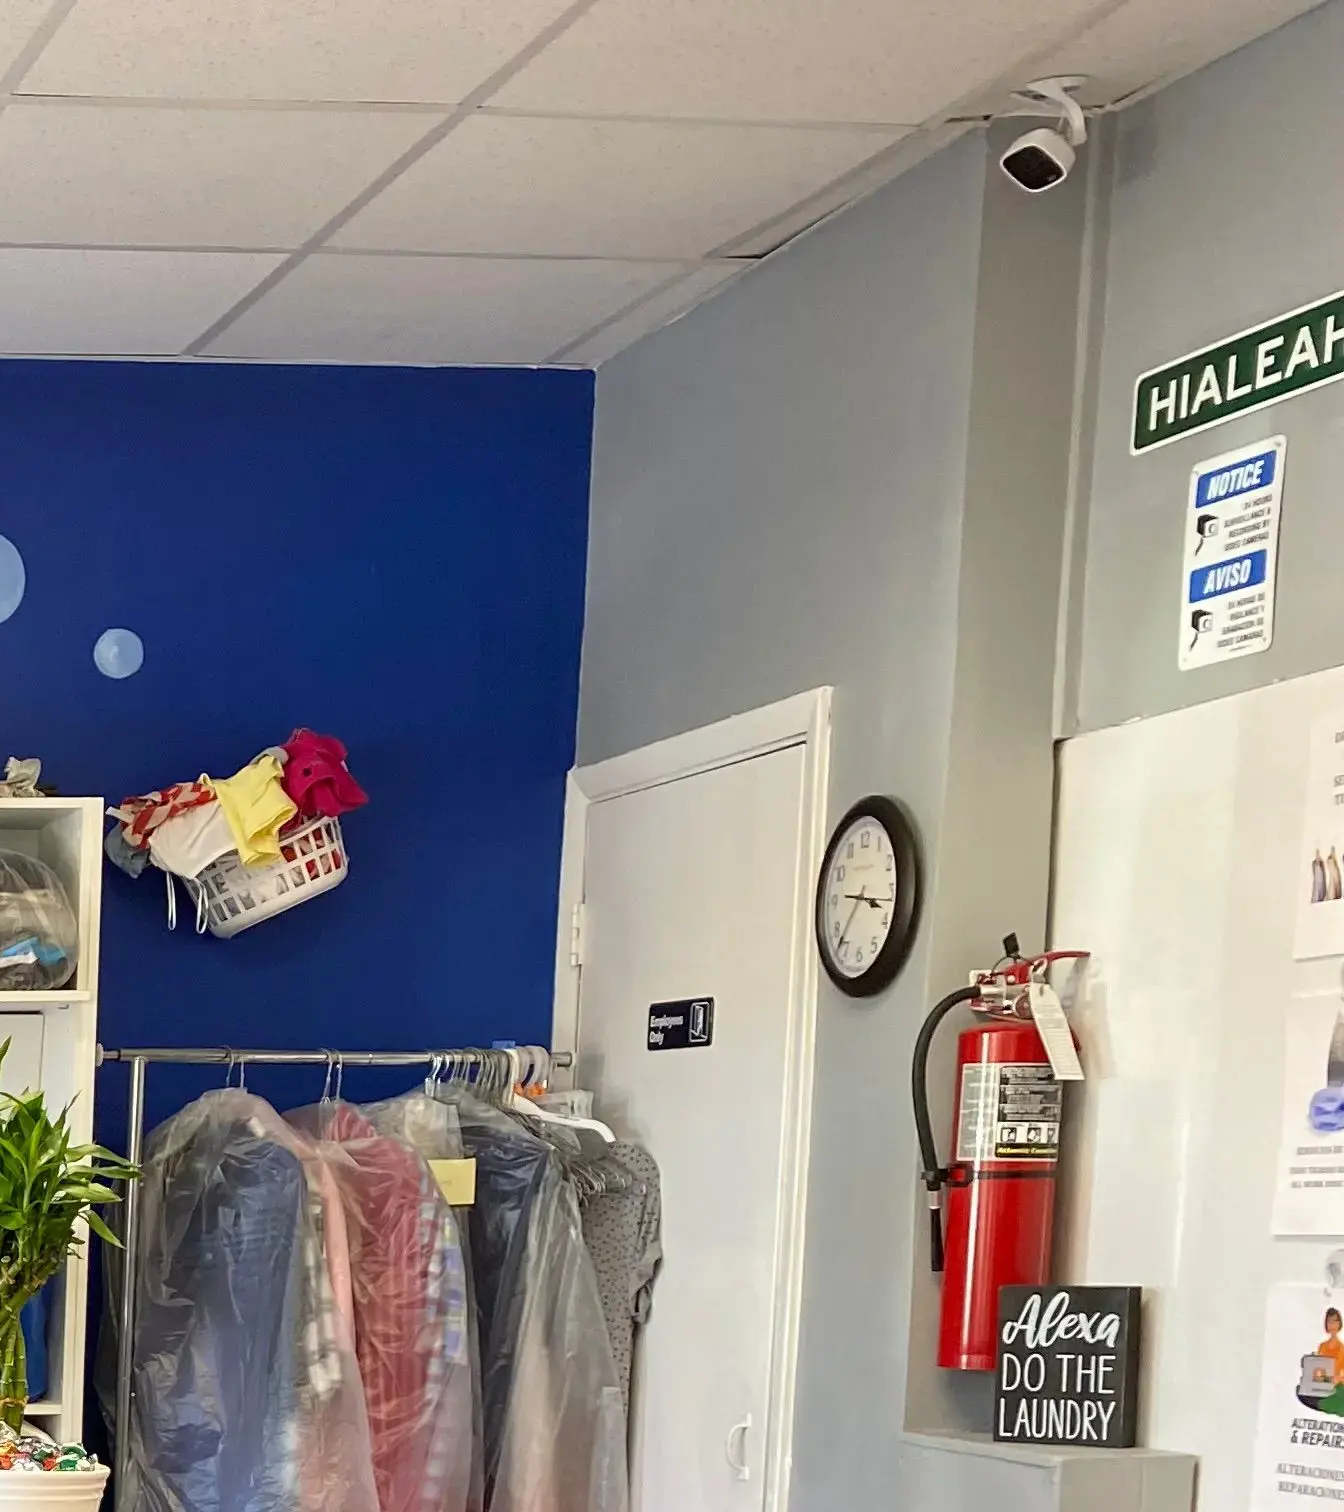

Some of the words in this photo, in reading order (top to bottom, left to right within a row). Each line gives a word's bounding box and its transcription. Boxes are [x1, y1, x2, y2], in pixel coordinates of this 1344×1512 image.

[1149, 315, 1344, 431] HIALEAH
[1207, 460, 1264, 501] NOTICE
[1204, 558, 1252, 594] AVISO
[1003, 1291, 1122, 1348] Alexa
[1003, 1353, 1046, 1392] DO
[1055, 1353, 1116, 1395] THE
[999, 1398, 1116, 1442] LAUNDRY
